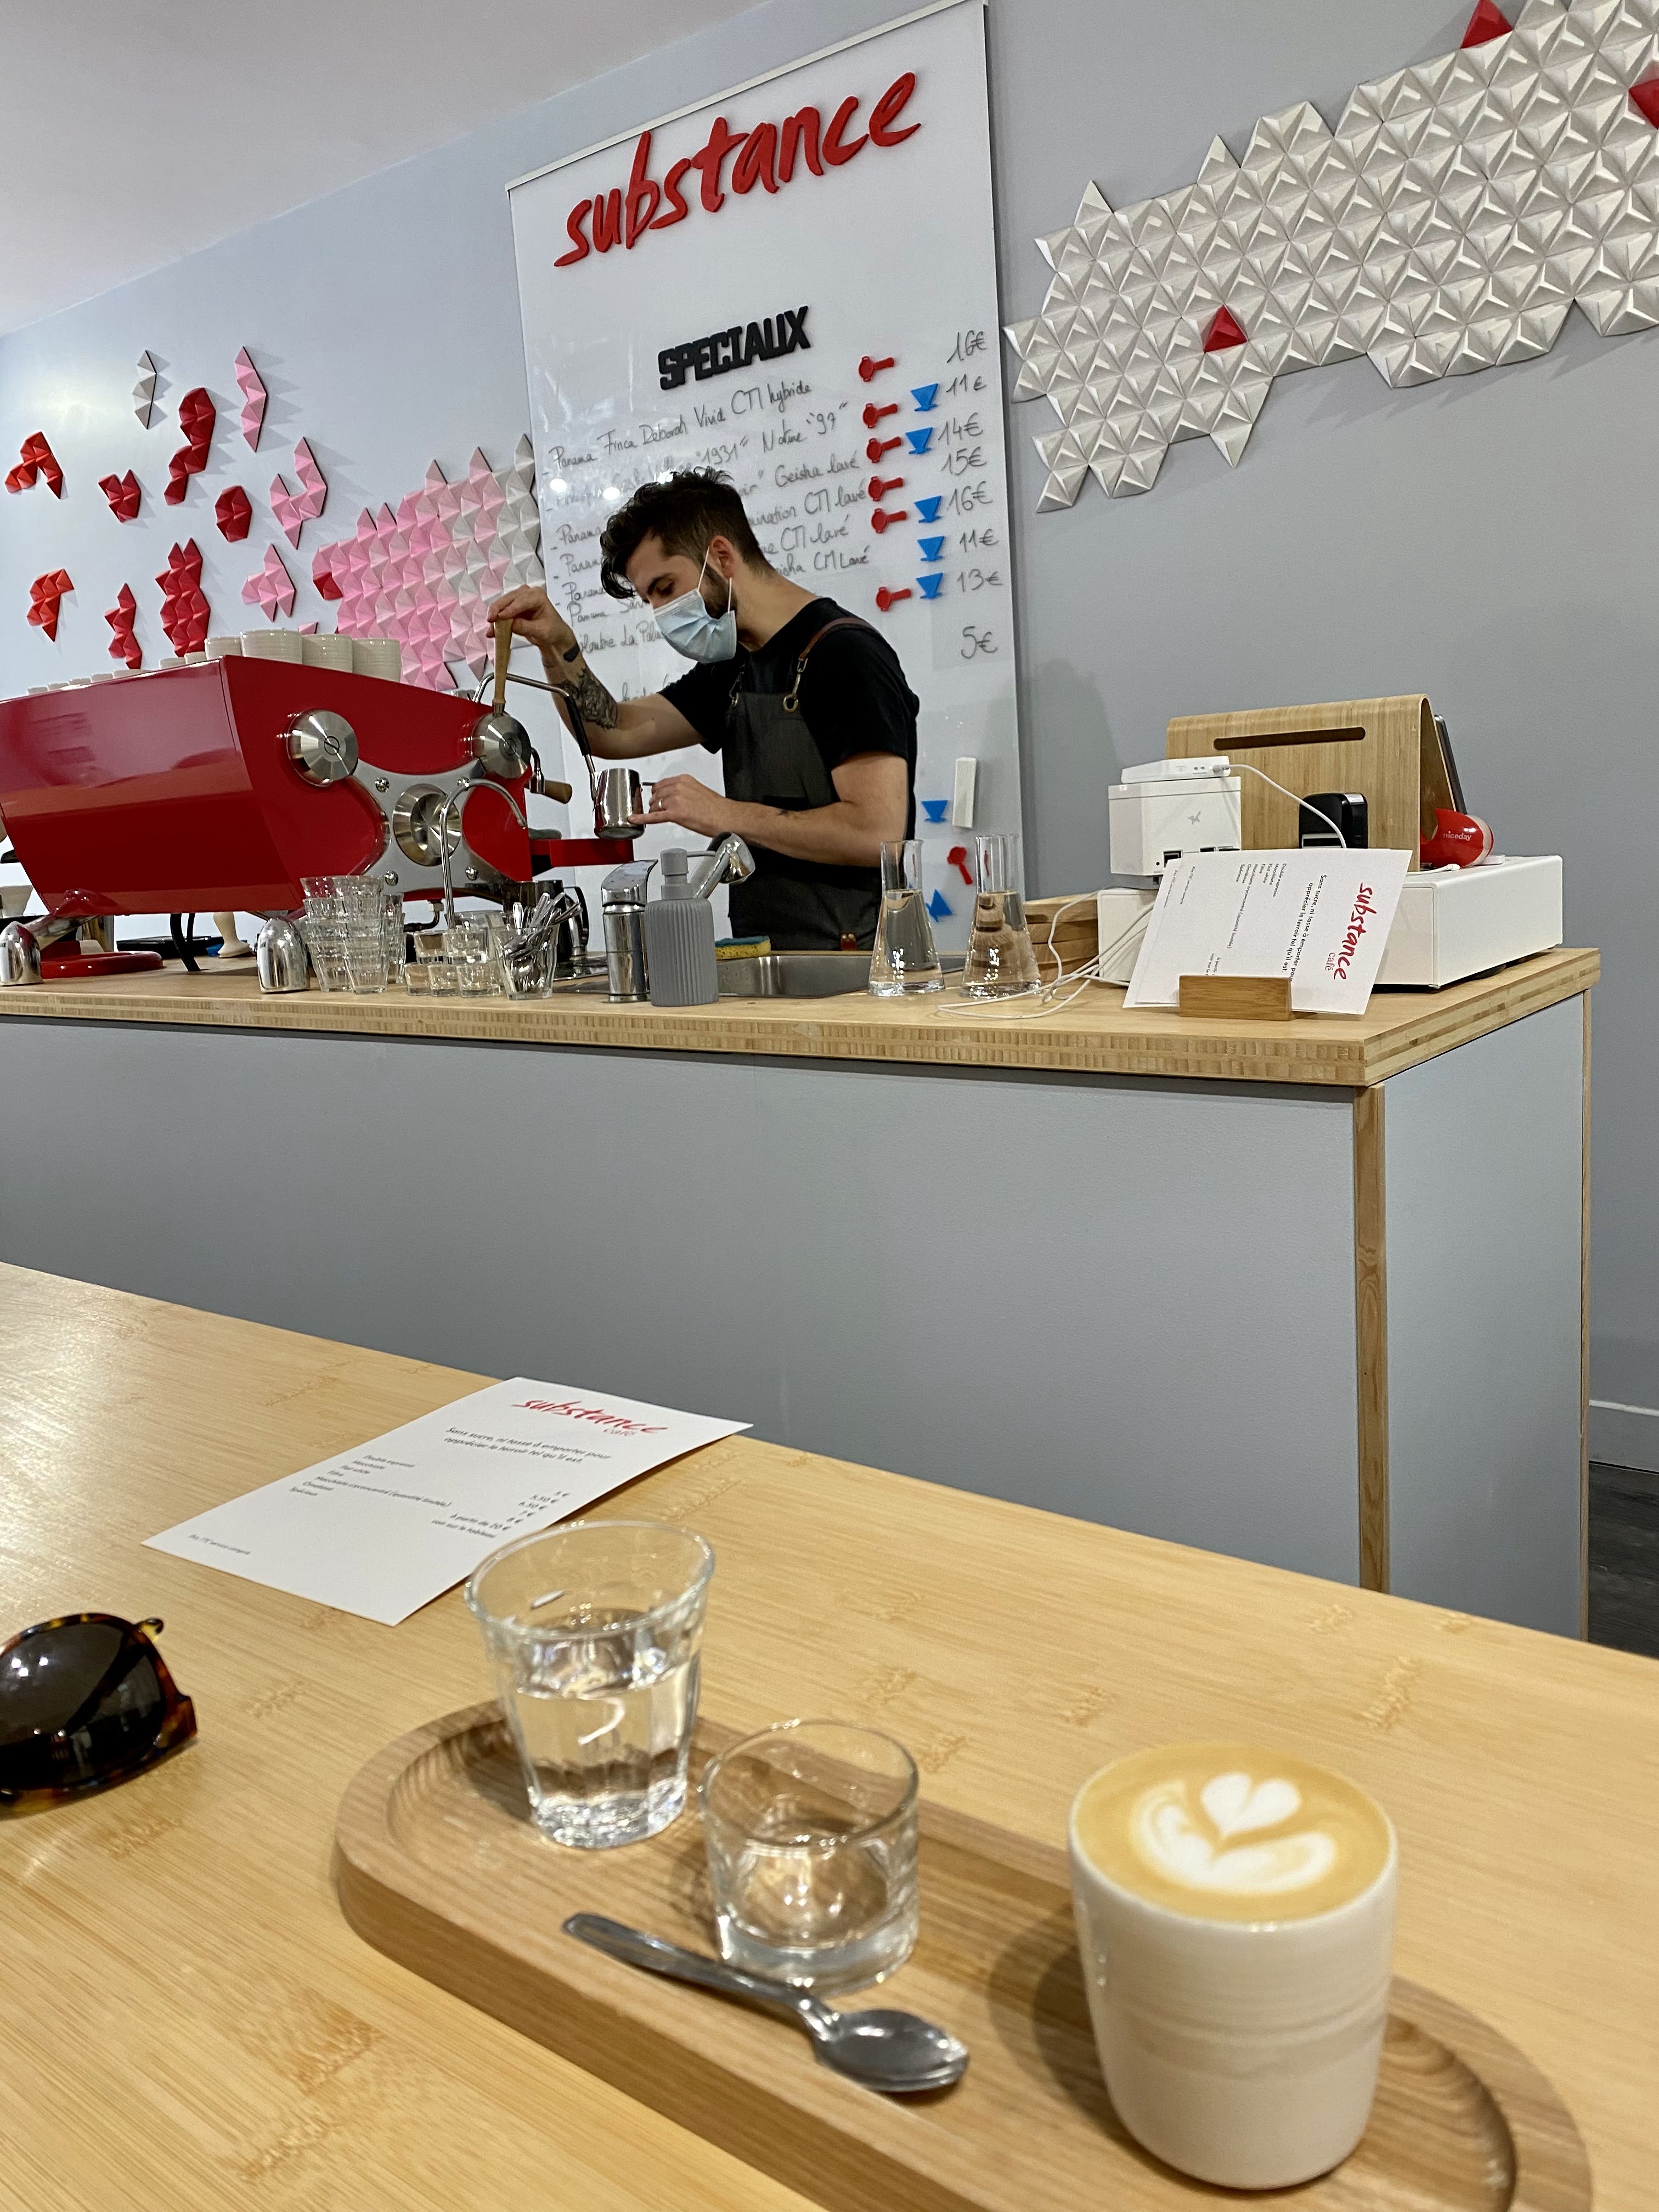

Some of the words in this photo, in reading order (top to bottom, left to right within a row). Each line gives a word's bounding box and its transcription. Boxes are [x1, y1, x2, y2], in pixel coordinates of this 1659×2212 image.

[554, 72, 922, 267] substance
[658, 306, 811, 390] SPECIAUX
[946, 330, 987, 363] 16€
[548, 445, 597, 469] Panama
[596, 429, 638, 455] Finca
[768, 380, 812, 413] hybride
[938, 412, 984, 445] 14€
[775, 464, 823, 488] Geisha
[827, 450, 859, 473] lavé
[940, 446, 987, 476] 15€
[947, 481, 993, 516] 16€
[960, 528, 999, 552] 11€
[957, 568, 1003, 592] 13€
[961, 625, 998, 659] 5€
[1443, 831, 1473, 842] niceday
[1316, 875, 1328, 889] Sans
[1301, 883, 1314, 911] apprécier
[1311, 890, 1320, 907] sucre,
[1293, 919, 1303, 937] terroir
[1304, 916, 1314, 932] tasse
[1334, 882, 1376, 979] substance
[1284, 947, 1294, 961] qu'il
[1293, 939, 1306, 967] emporter
[1324, 952, 1335, 970] café
[511, 1400, 668, 1434] substance
